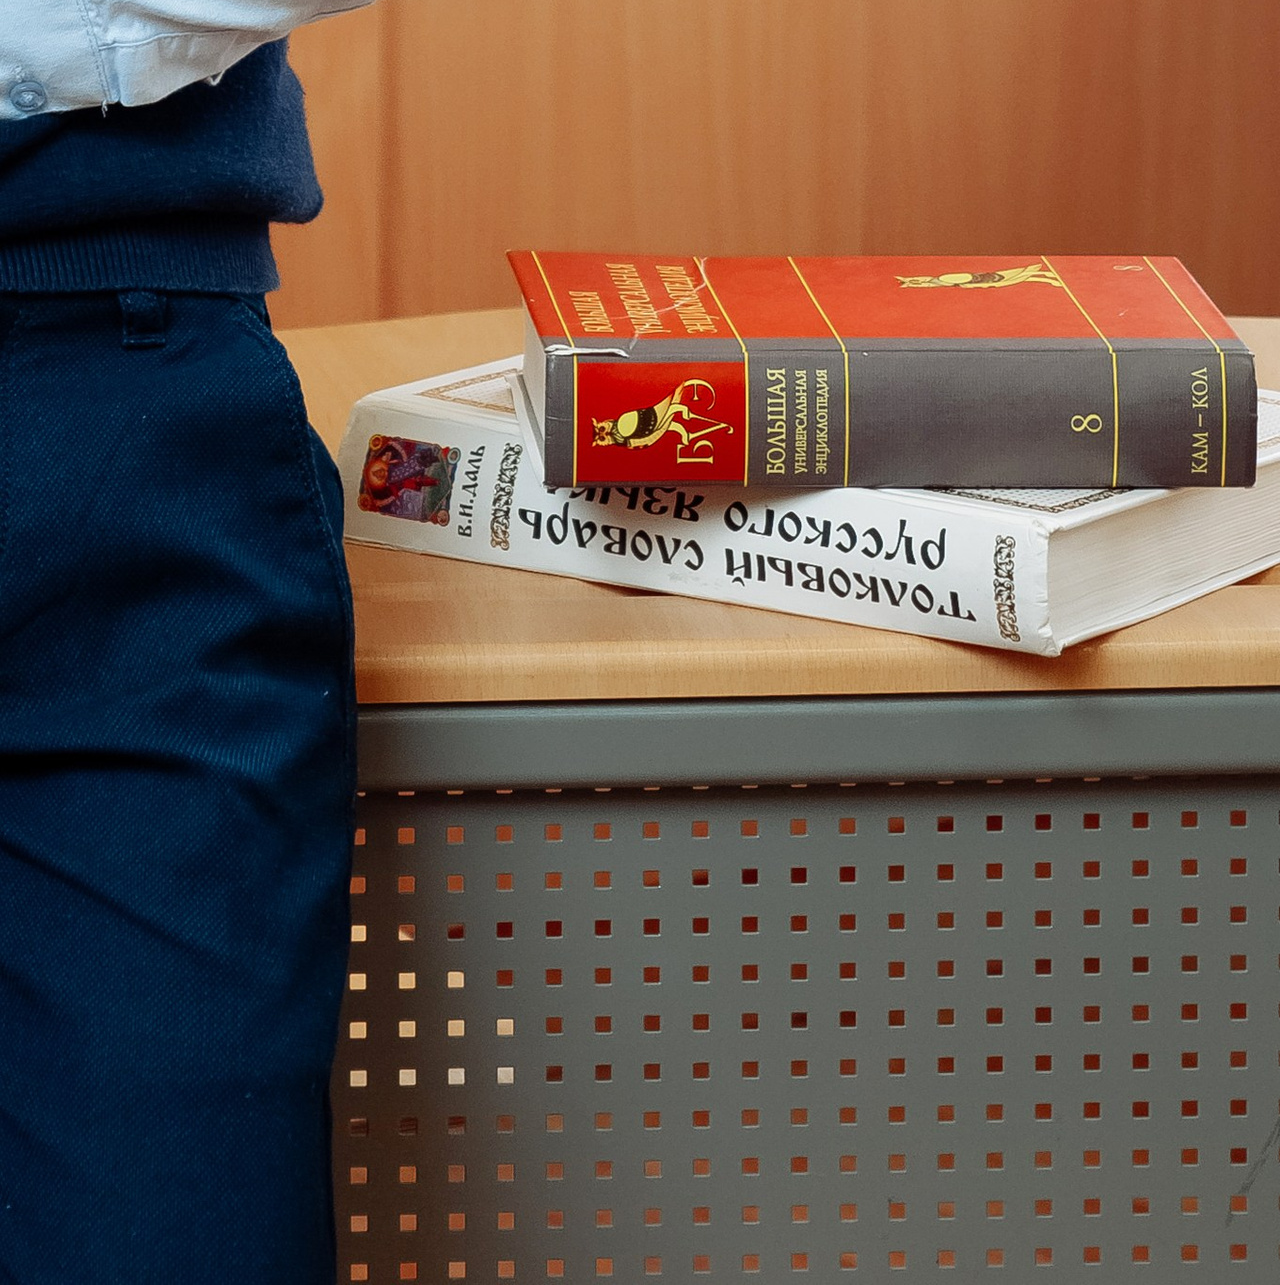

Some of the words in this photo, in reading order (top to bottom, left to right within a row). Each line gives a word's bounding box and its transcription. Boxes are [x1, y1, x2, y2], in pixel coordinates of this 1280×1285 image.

[568, 291, 615, 333] БОЛЬШАЯ
[605, 263, 672, 335] УНИВЕРСАЛЬНАЯ
[676, 378, 734, 465] БУЭ
[766, 367, 786, 475] БОЛЬШАЯ
[794, 369, 807, 474] УНИВЕРСАЛЬНАЯ
[815, 369, 828, 475] ЭНЦИКЛОПЕДИЯ
[1070, 413, 1103, 434] 8
[1191, 367, 1209, 409] КОЛ
[1191, 432, 1209, 473] КАМ
